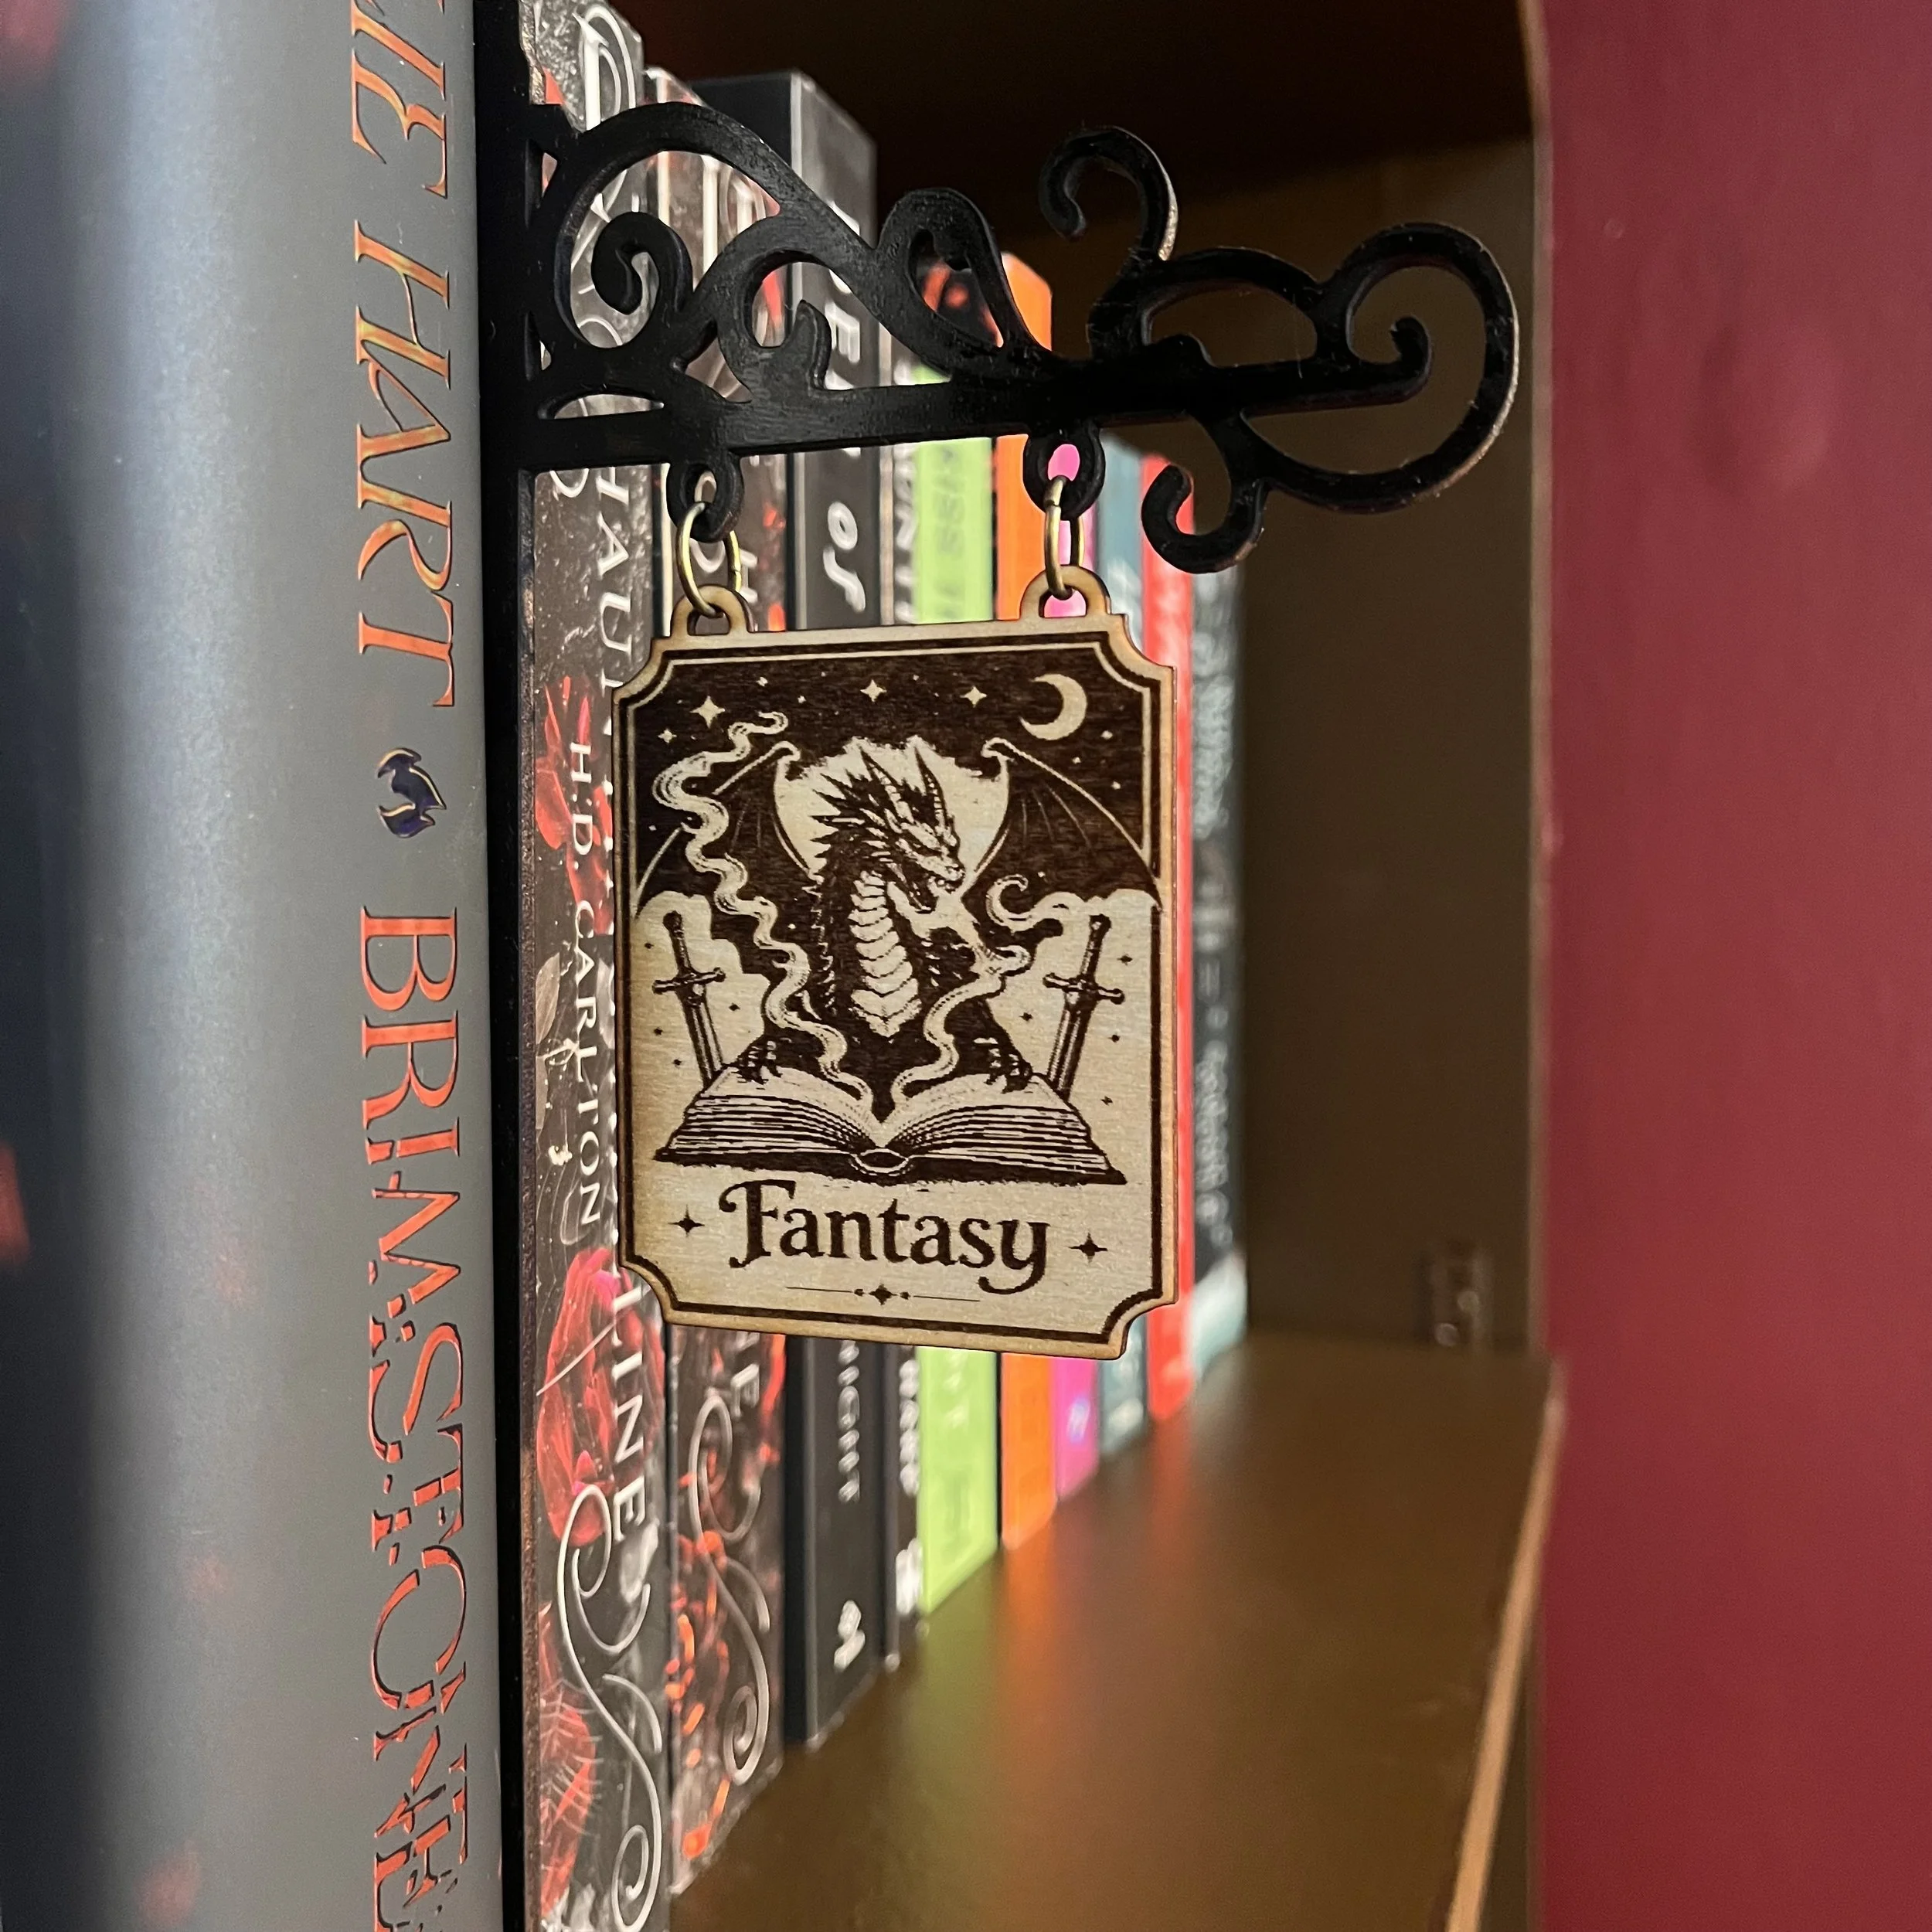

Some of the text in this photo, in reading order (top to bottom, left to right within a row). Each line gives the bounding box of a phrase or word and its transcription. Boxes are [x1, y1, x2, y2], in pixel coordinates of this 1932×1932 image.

[352, 0, 454, 708] IE HART
[572, 900, 600, 1225] CARLTON
[608, 1232, 648, 1543] LINE
[718, 1179, 1051, 1295] Fantasy
[359, 906, 468, 1932] BRIMSTONE
